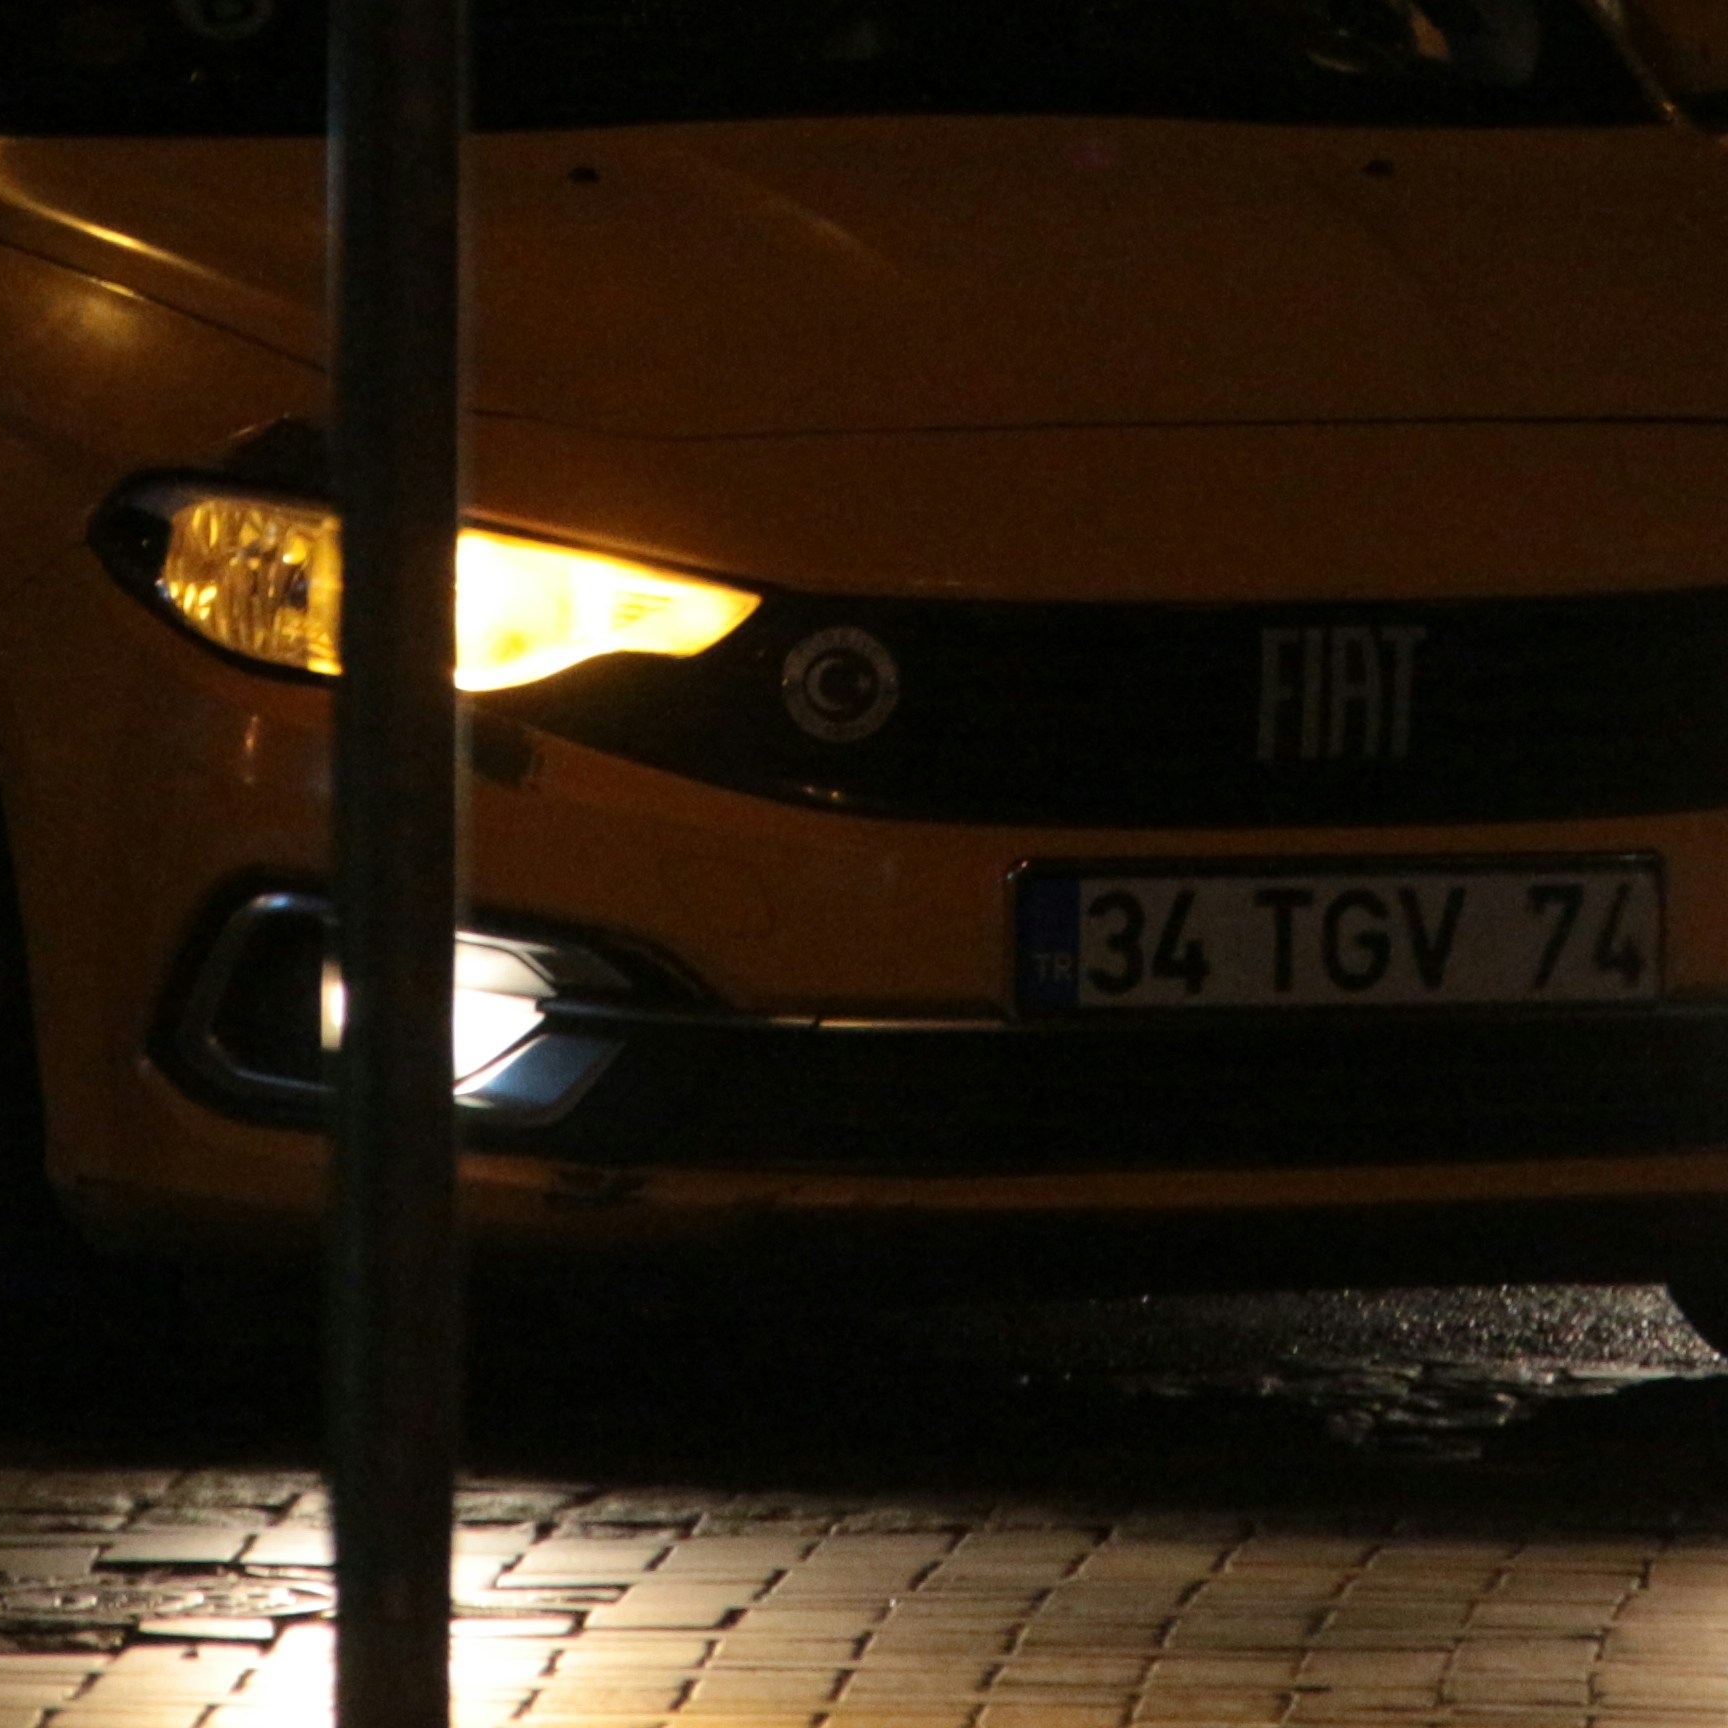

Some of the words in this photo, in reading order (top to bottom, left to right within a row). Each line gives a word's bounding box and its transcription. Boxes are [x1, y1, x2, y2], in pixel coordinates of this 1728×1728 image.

[1256, 624, 1428, 760] FIAT
[1030, 952, 1074, 983] TR
[1087, 888, 1208, 996] 34
[1253, 886, 1466, 992] TGV
[1526, 882, 1646, 991] 74
